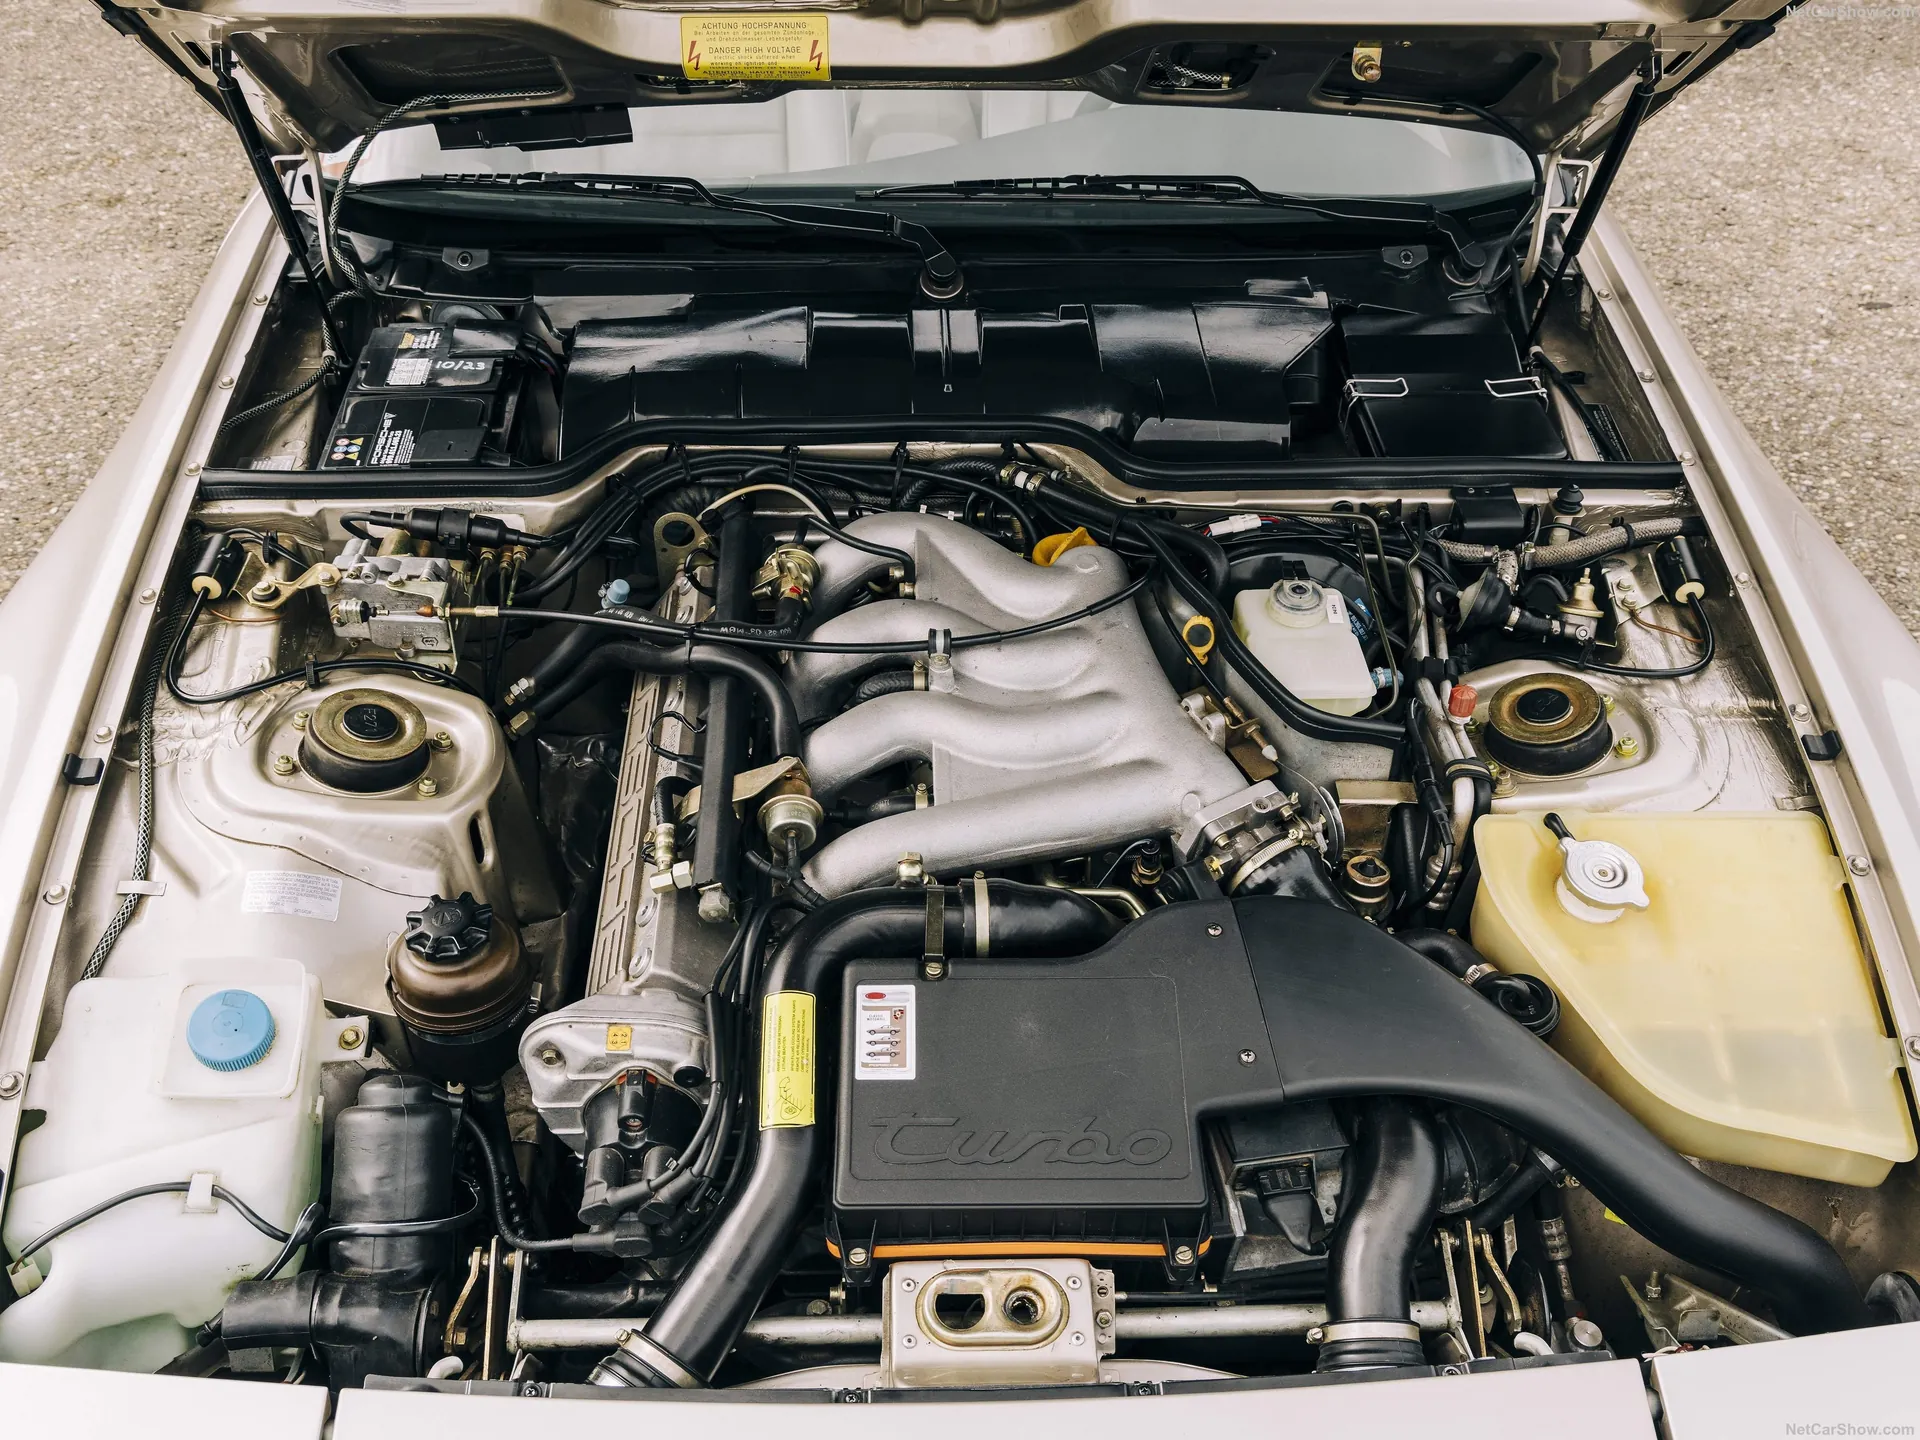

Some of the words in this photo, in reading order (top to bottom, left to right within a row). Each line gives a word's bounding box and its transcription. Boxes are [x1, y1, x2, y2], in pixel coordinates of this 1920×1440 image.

[702, 22, 739, 30] ACHTUNG
[742, 21, 807, 30] HOCHSPANNUNG
[436, 360, 486, 371] 10/23
[370, 418, 393, 465] PORSCHE
